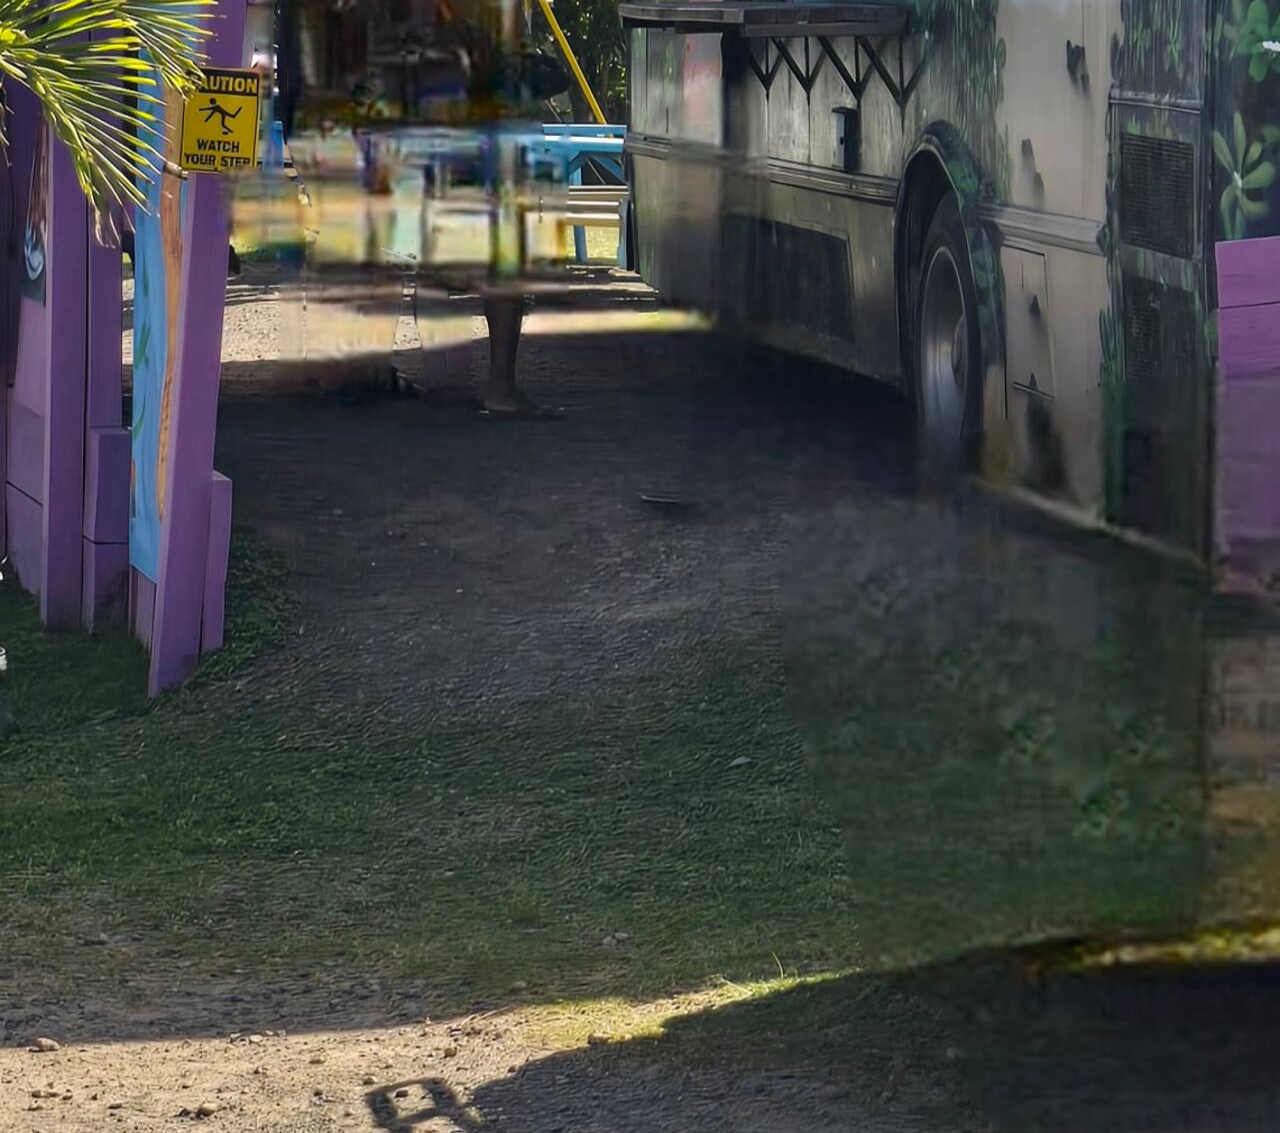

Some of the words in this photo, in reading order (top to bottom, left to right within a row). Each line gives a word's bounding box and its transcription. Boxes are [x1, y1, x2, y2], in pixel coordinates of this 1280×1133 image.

[190, 74, 258, 93] AUTION
[196, 138, 240, 153] WATCH
[184, 152, 216, 166] YOUR
[220, 155, 251, 167] STEP
